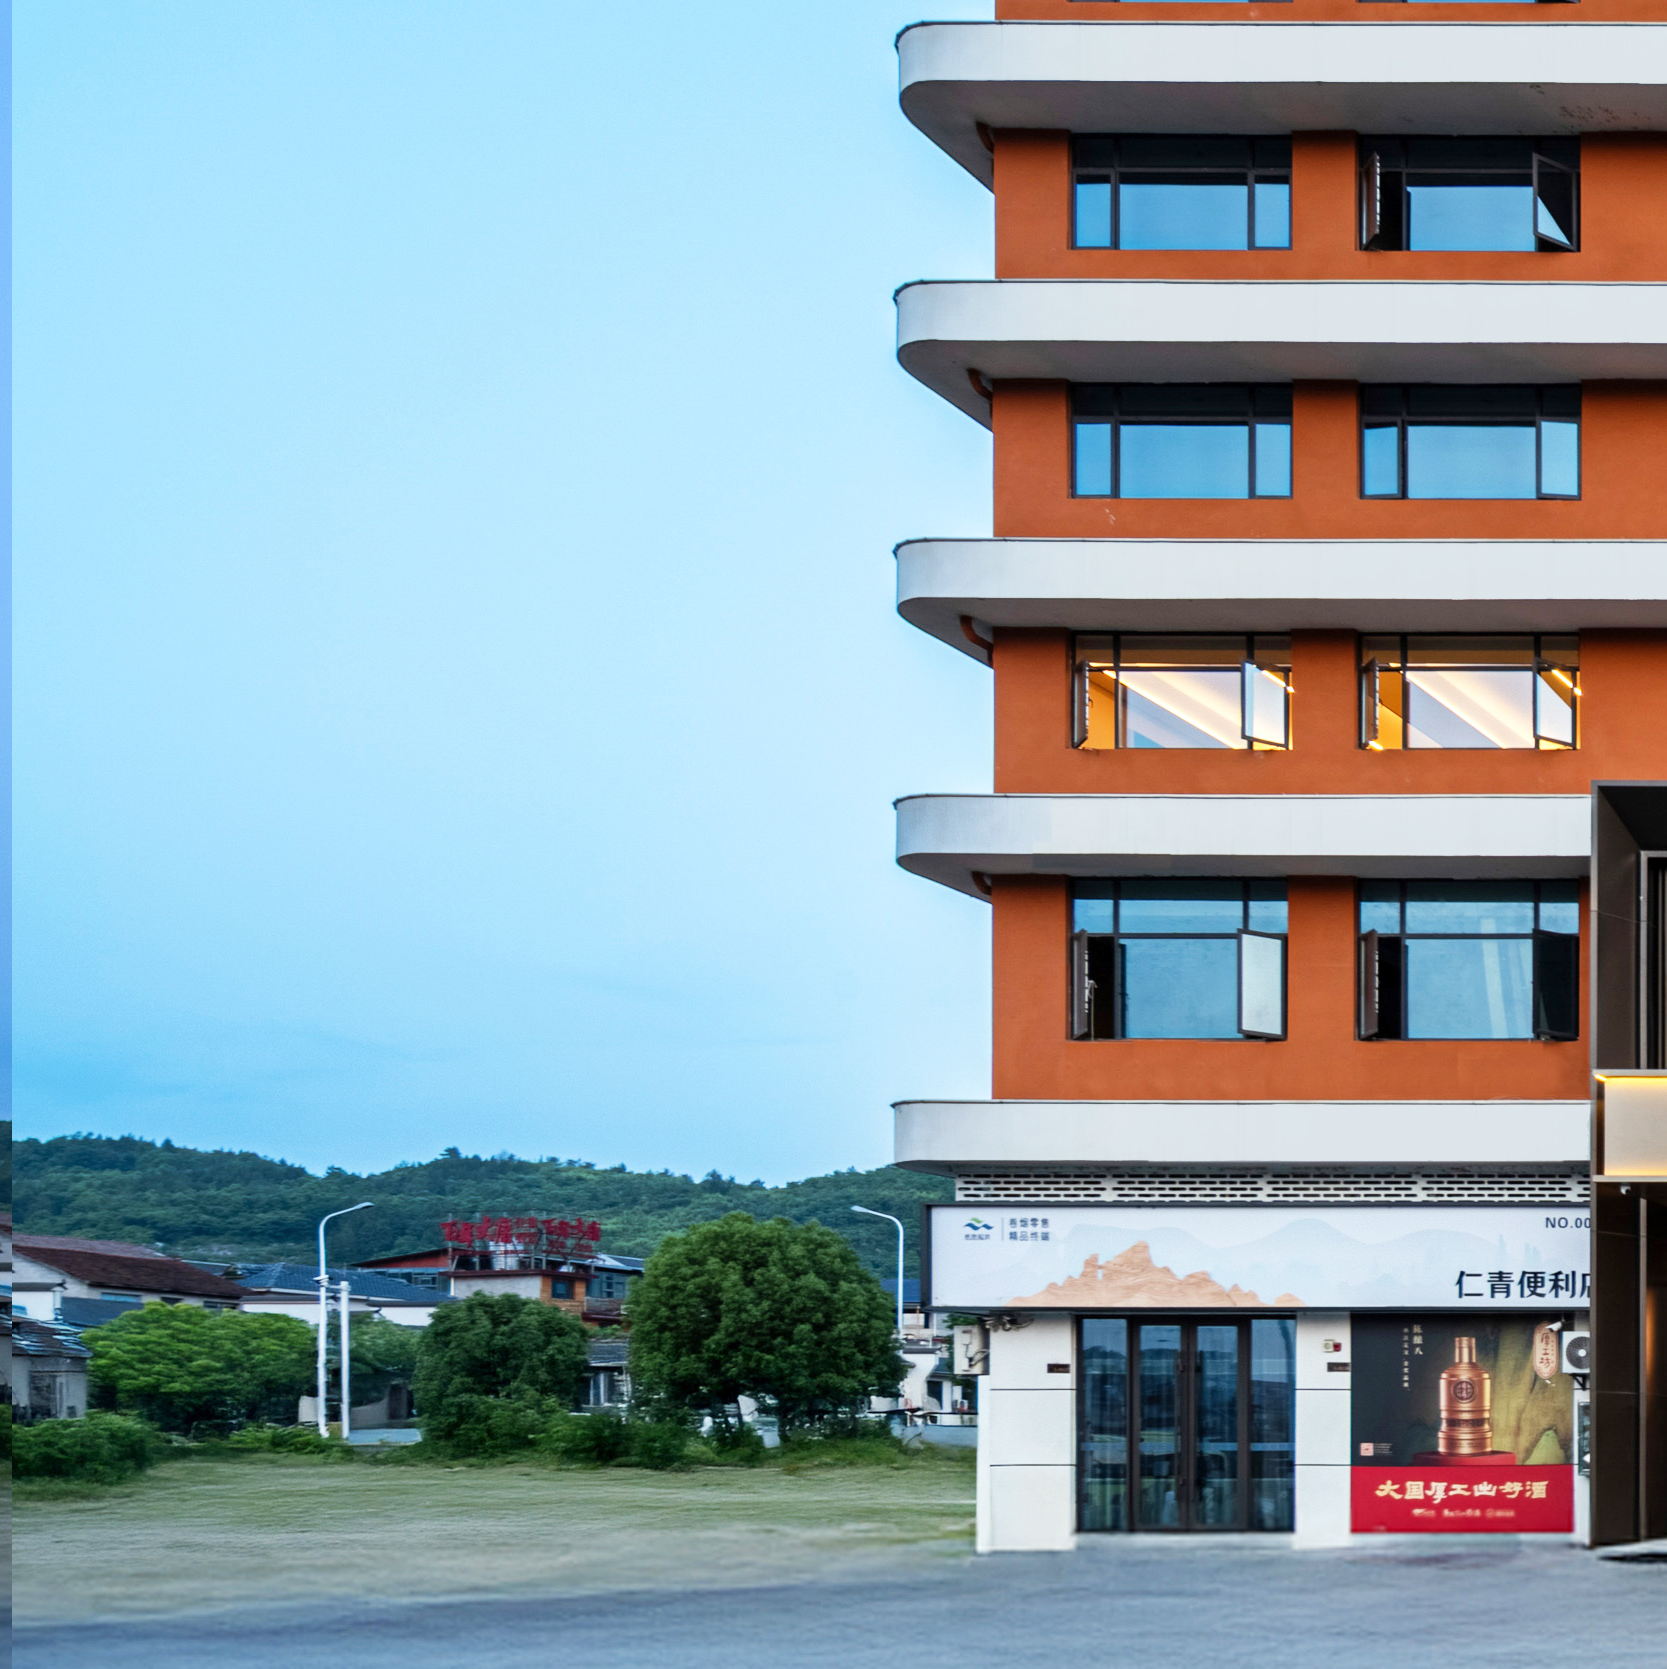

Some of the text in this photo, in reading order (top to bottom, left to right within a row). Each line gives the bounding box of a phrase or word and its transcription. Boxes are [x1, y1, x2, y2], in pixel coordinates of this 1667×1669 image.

[1374, 1479, 1550, 1504] 大国厚工出好酒
